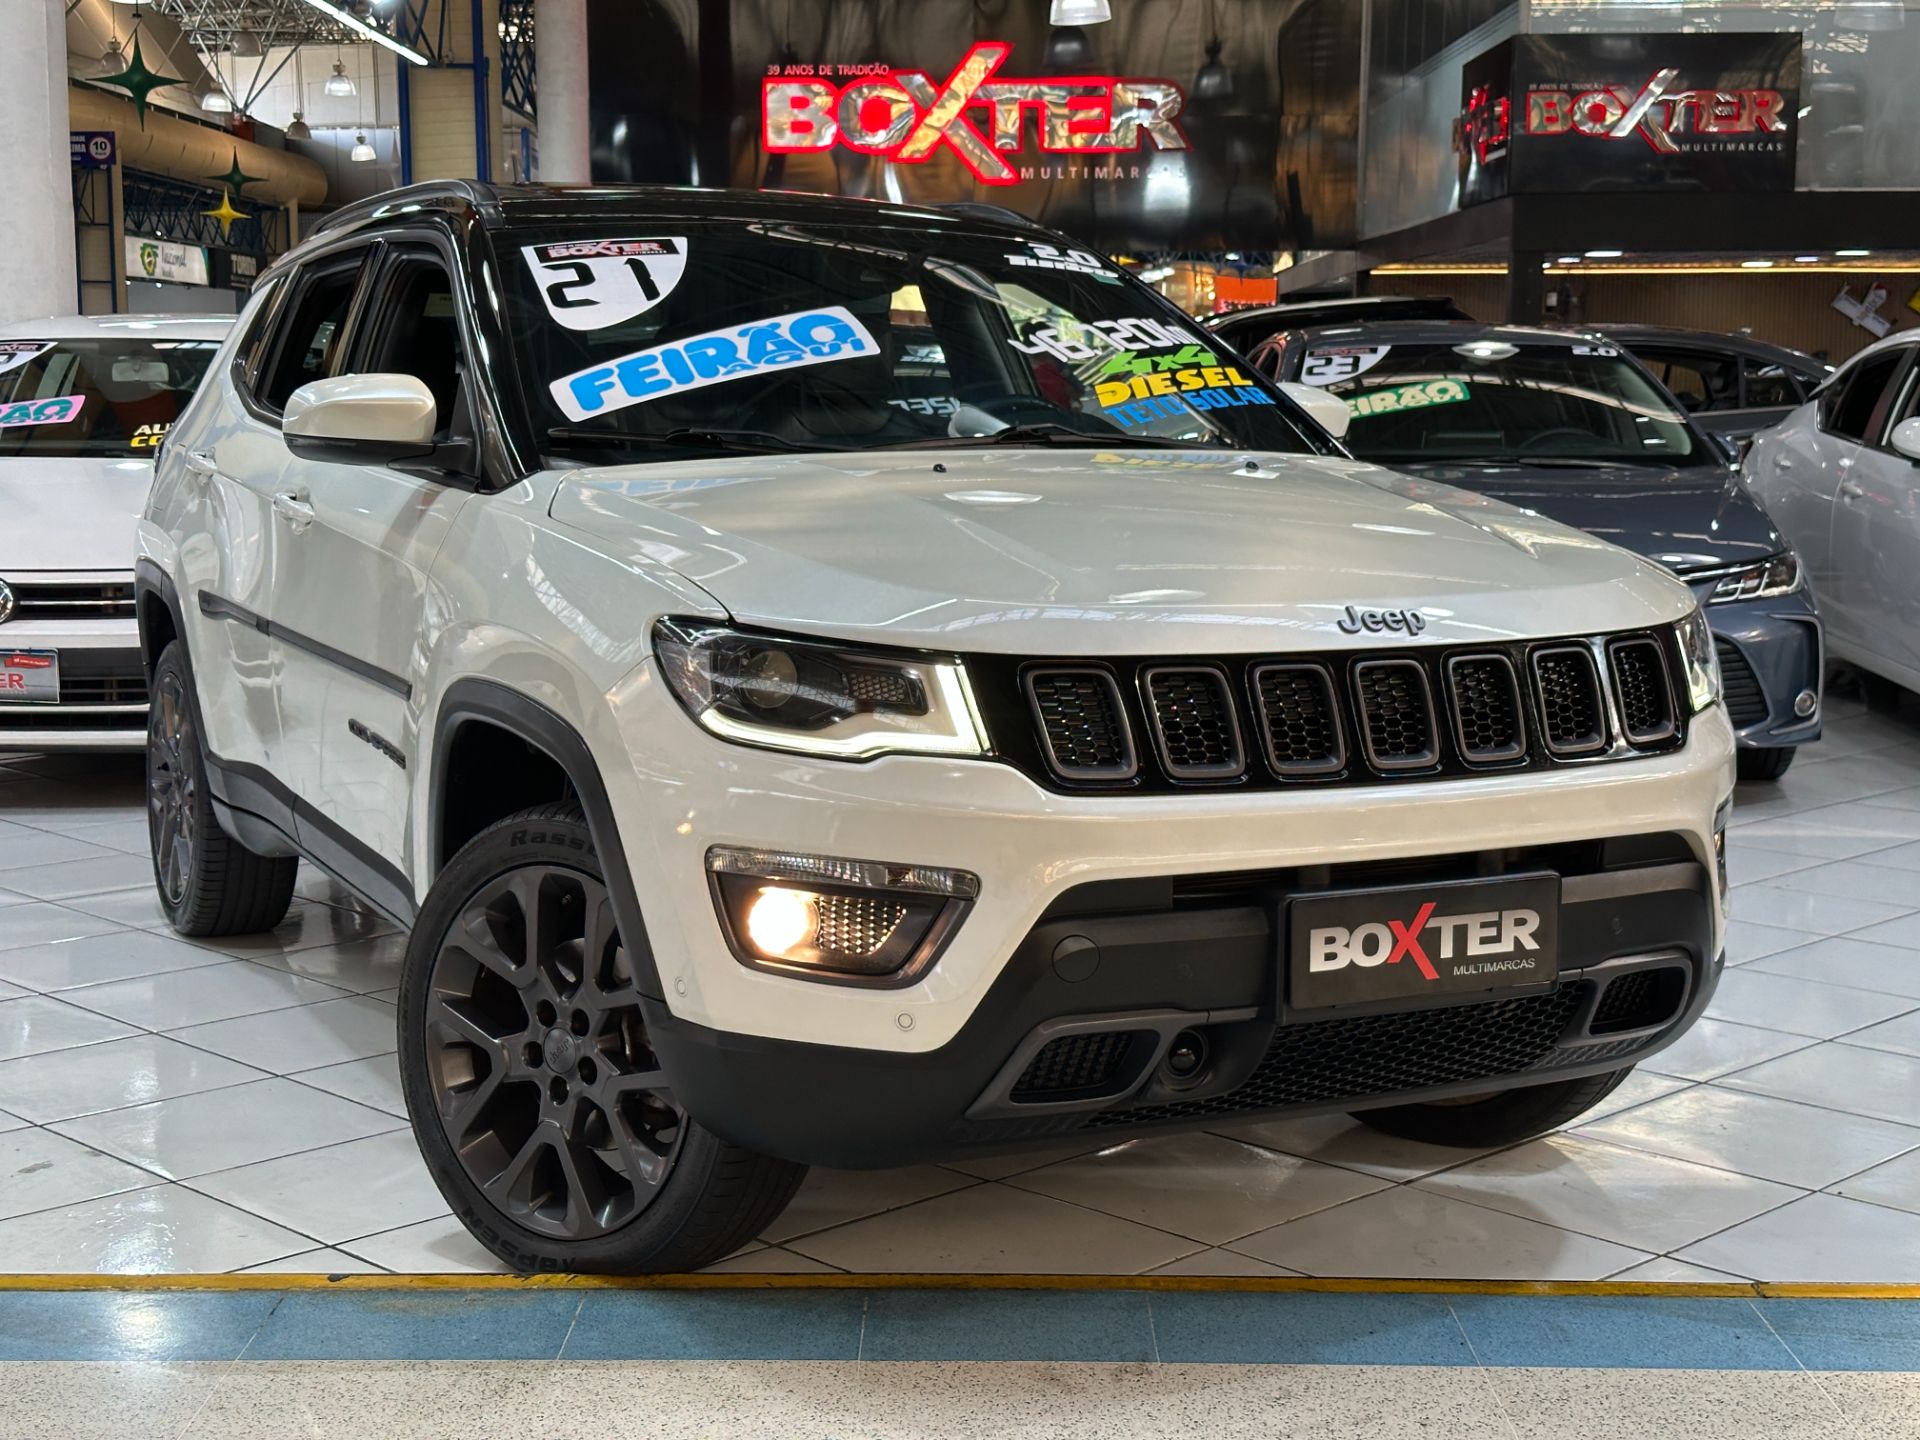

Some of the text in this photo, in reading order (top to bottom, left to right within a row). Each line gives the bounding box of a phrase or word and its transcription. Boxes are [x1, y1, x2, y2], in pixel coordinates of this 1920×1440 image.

[767, 62, 889, 77] 39 ANOS DE TRADIÇÃO
[763, 41, 1193, 185] BOXTER
[1526, 67, 1787, 154] BOXTER
[93, 141, 107, 151] 10
[1681, 142, 1784, 153] MULTIMARCAS
[547, 240, 666, 259] BOXTER
[1027, 243, 1102, 268] 2.0
[541, 257, 661, 309] 21
[569, 313, 858, 412] FEIRÃO
[1101, 344, 1218, 374] 4x4
[1305, 355, 1361, 377] 23
[1094, 366, 1254, 408] DIESEL
[1104, 385, 1277, 429] TETO SOLAR
[1336, 605, 1427, 637] Jeep
[1308, 901, 1541, 981] BOXTER
[1453, 957, 1537, 977] MULTIMARCAS
